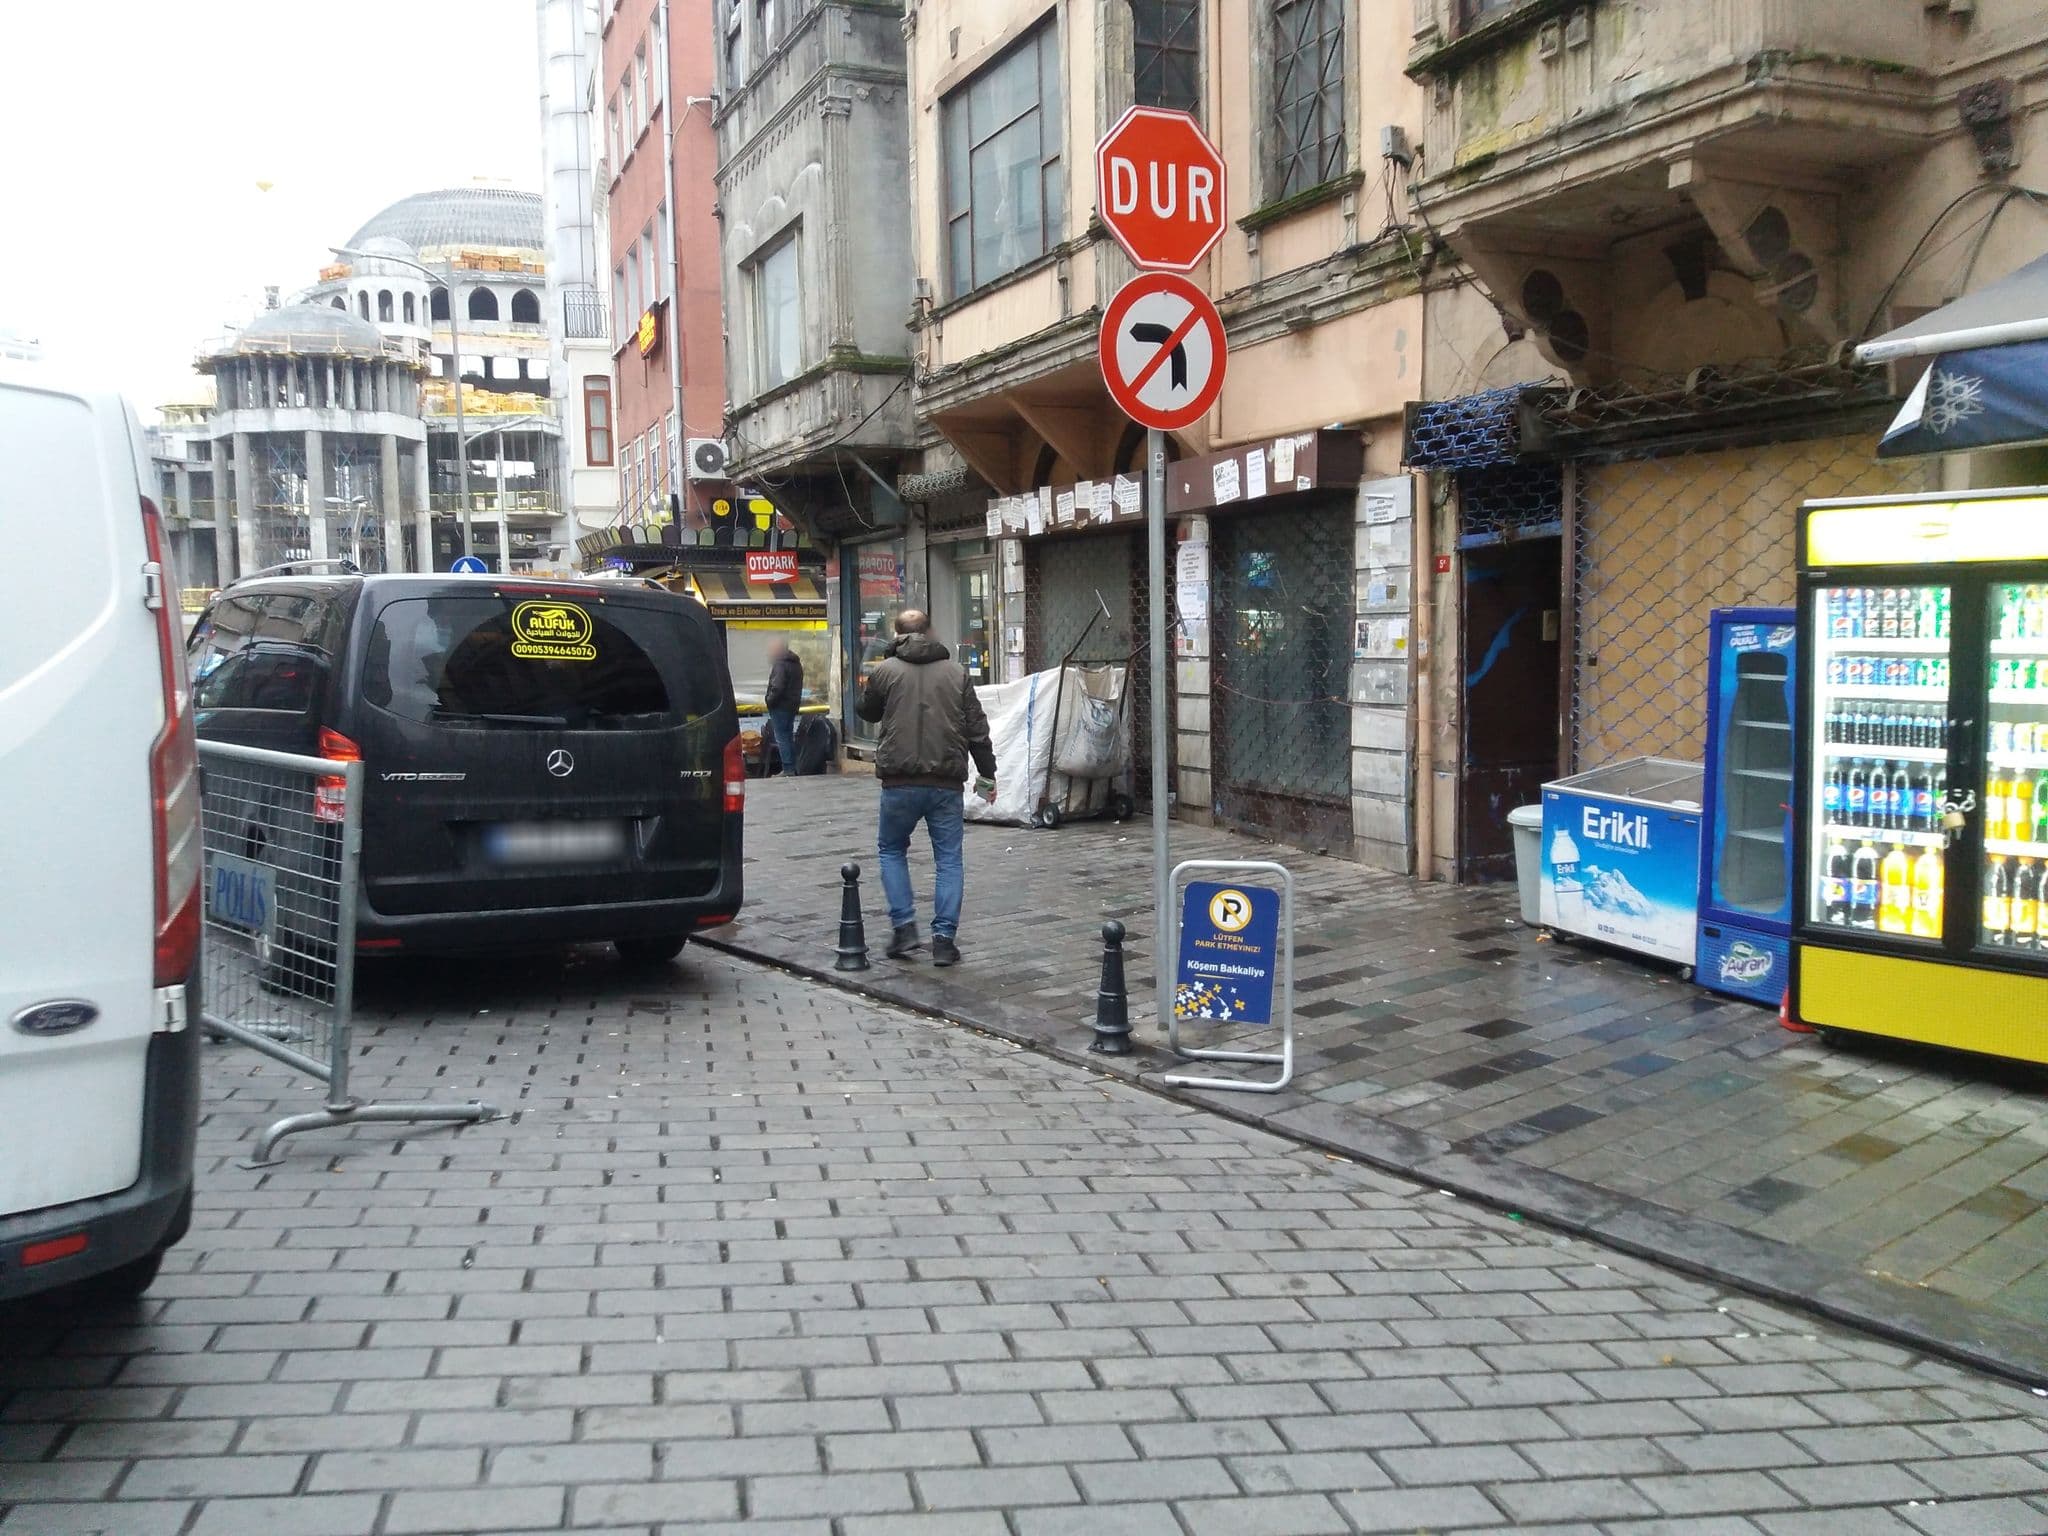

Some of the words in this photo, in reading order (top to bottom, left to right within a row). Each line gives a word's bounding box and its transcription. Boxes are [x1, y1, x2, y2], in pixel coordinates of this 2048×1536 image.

[1110, 156, 1215, 224] DUR
[749, 554, 796, 572] OTOPARK
[789, 606, 795, 616] &
[529, 617, 576, 631] ALUFUK
[515, 644, 593, 657] 00905394645074
[381, 772, 418, 781] VITO
[1583, 806, 1649, 849] Erikli
[214, 866, 267, 927] POLİS
[1195, 939, 1216, 949] PARK
[1213, 933, 1244, 944] LÜTFEN
[1187, 959, 1219, 973] Köşem
[1220, 962, 1265, 978] Bakkaliye
[1726, 957, 1766, 976] Ayran
